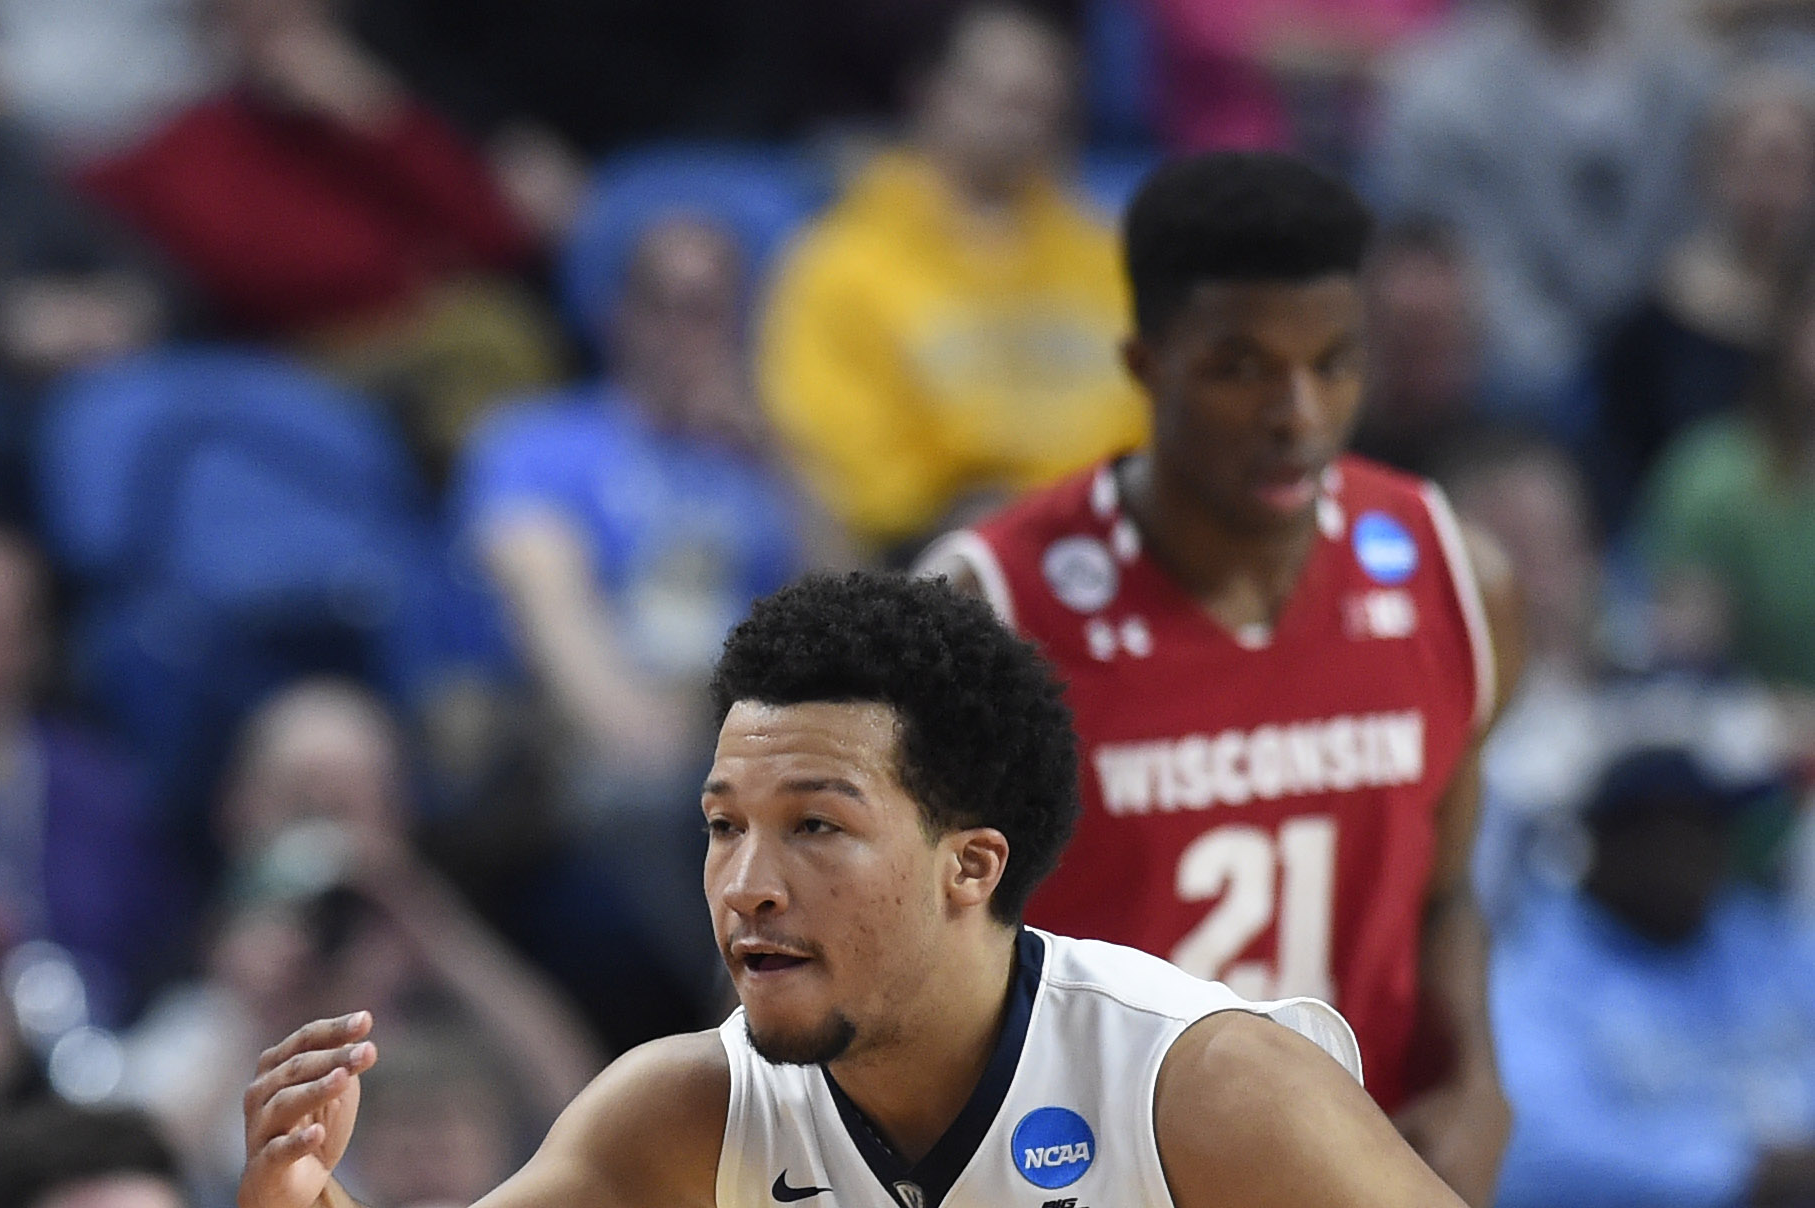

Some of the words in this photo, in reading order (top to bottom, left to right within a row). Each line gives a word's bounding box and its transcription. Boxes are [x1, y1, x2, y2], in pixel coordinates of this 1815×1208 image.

[1095, 711, 1425, 814] WISCONSIN
[1170, 815, 1341, 1006] 21
[1024, 1141, 1090, 1169] NCAA
